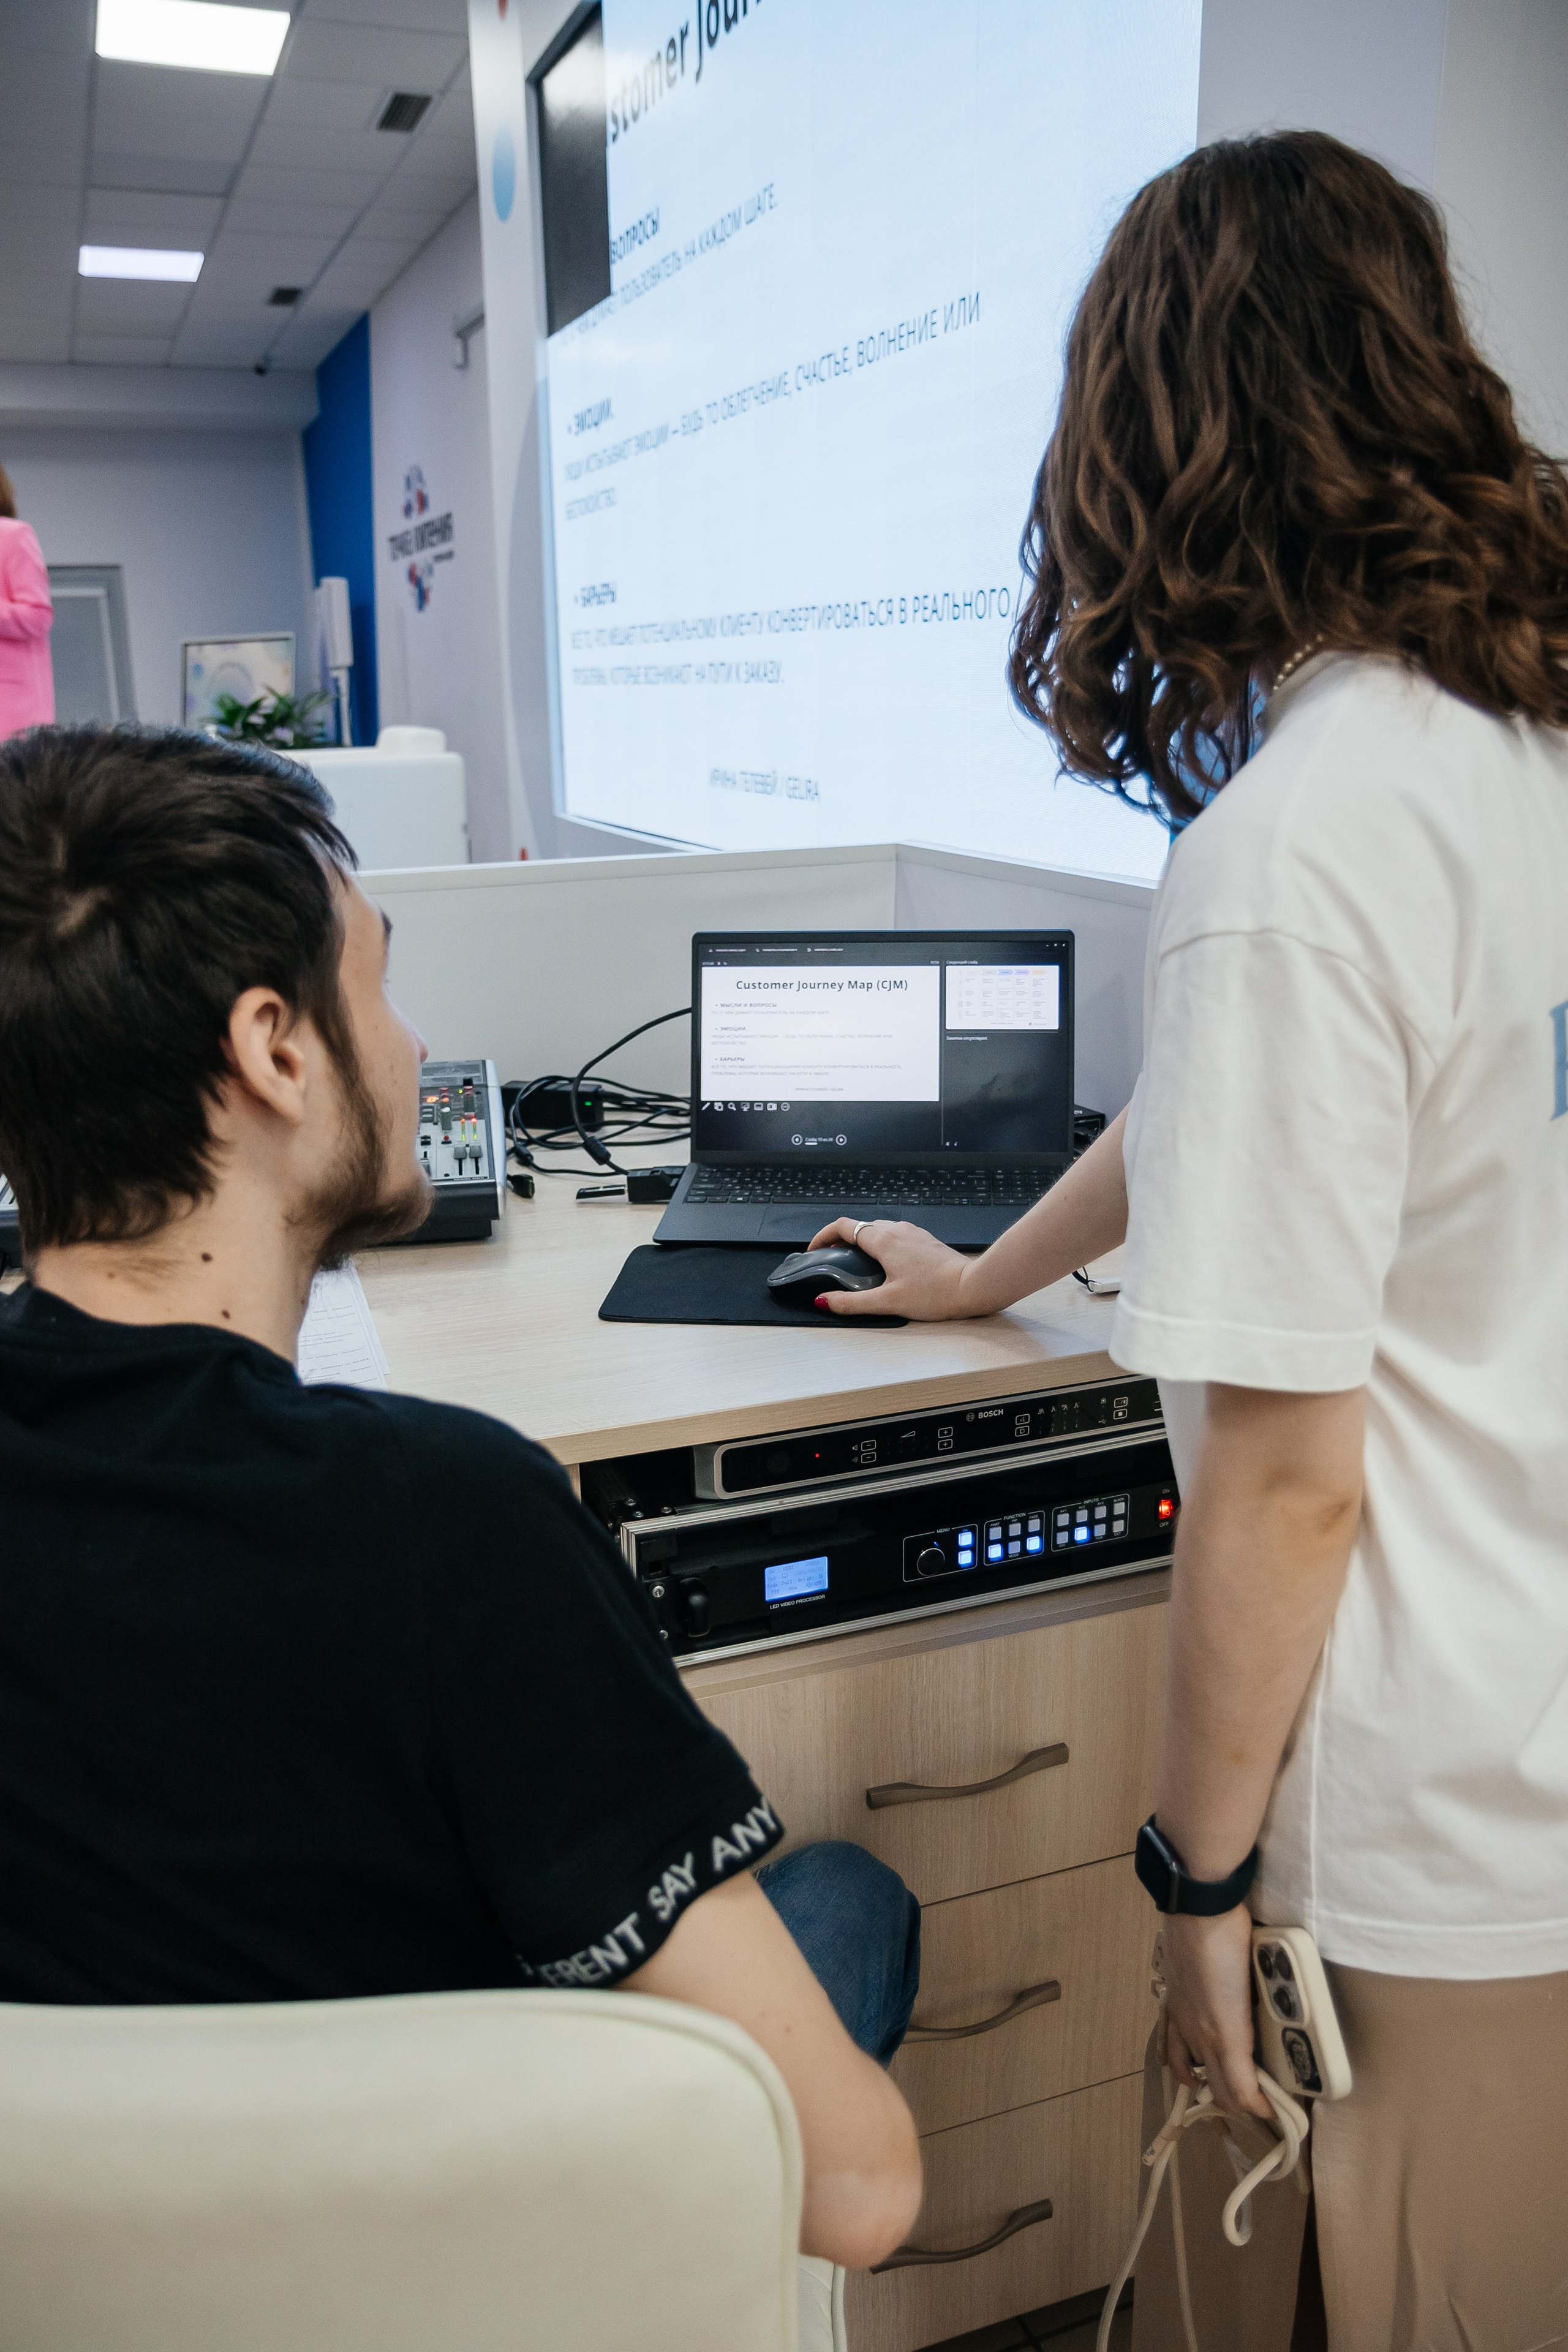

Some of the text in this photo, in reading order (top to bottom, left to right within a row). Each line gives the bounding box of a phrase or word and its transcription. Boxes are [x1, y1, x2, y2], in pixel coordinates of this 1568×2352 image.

[612, 21, 688, 143] stomer
[795, 346, 852, 391] СЧАСТЬЕ,
[858, 308, 937, 367] ВОЛНЕНИЕ
[943, 291, 979, 334] ИЛИ
[767, 598, 894, 633] КОНВЕРТИРОВАТЬСЯ
[900, 597, 907, 625] В
[913, 587, 1015, 623] РЕАЛЬНОГО,
[736, 980, 908, 992] Customer Journey Map (CJM)
[978, 1408, 1004, 1419] BOSCH
[796, 1594, 826, 1604] PROCESSOR
[516, 1795, 778, 1988] ERENT SAY ANY
